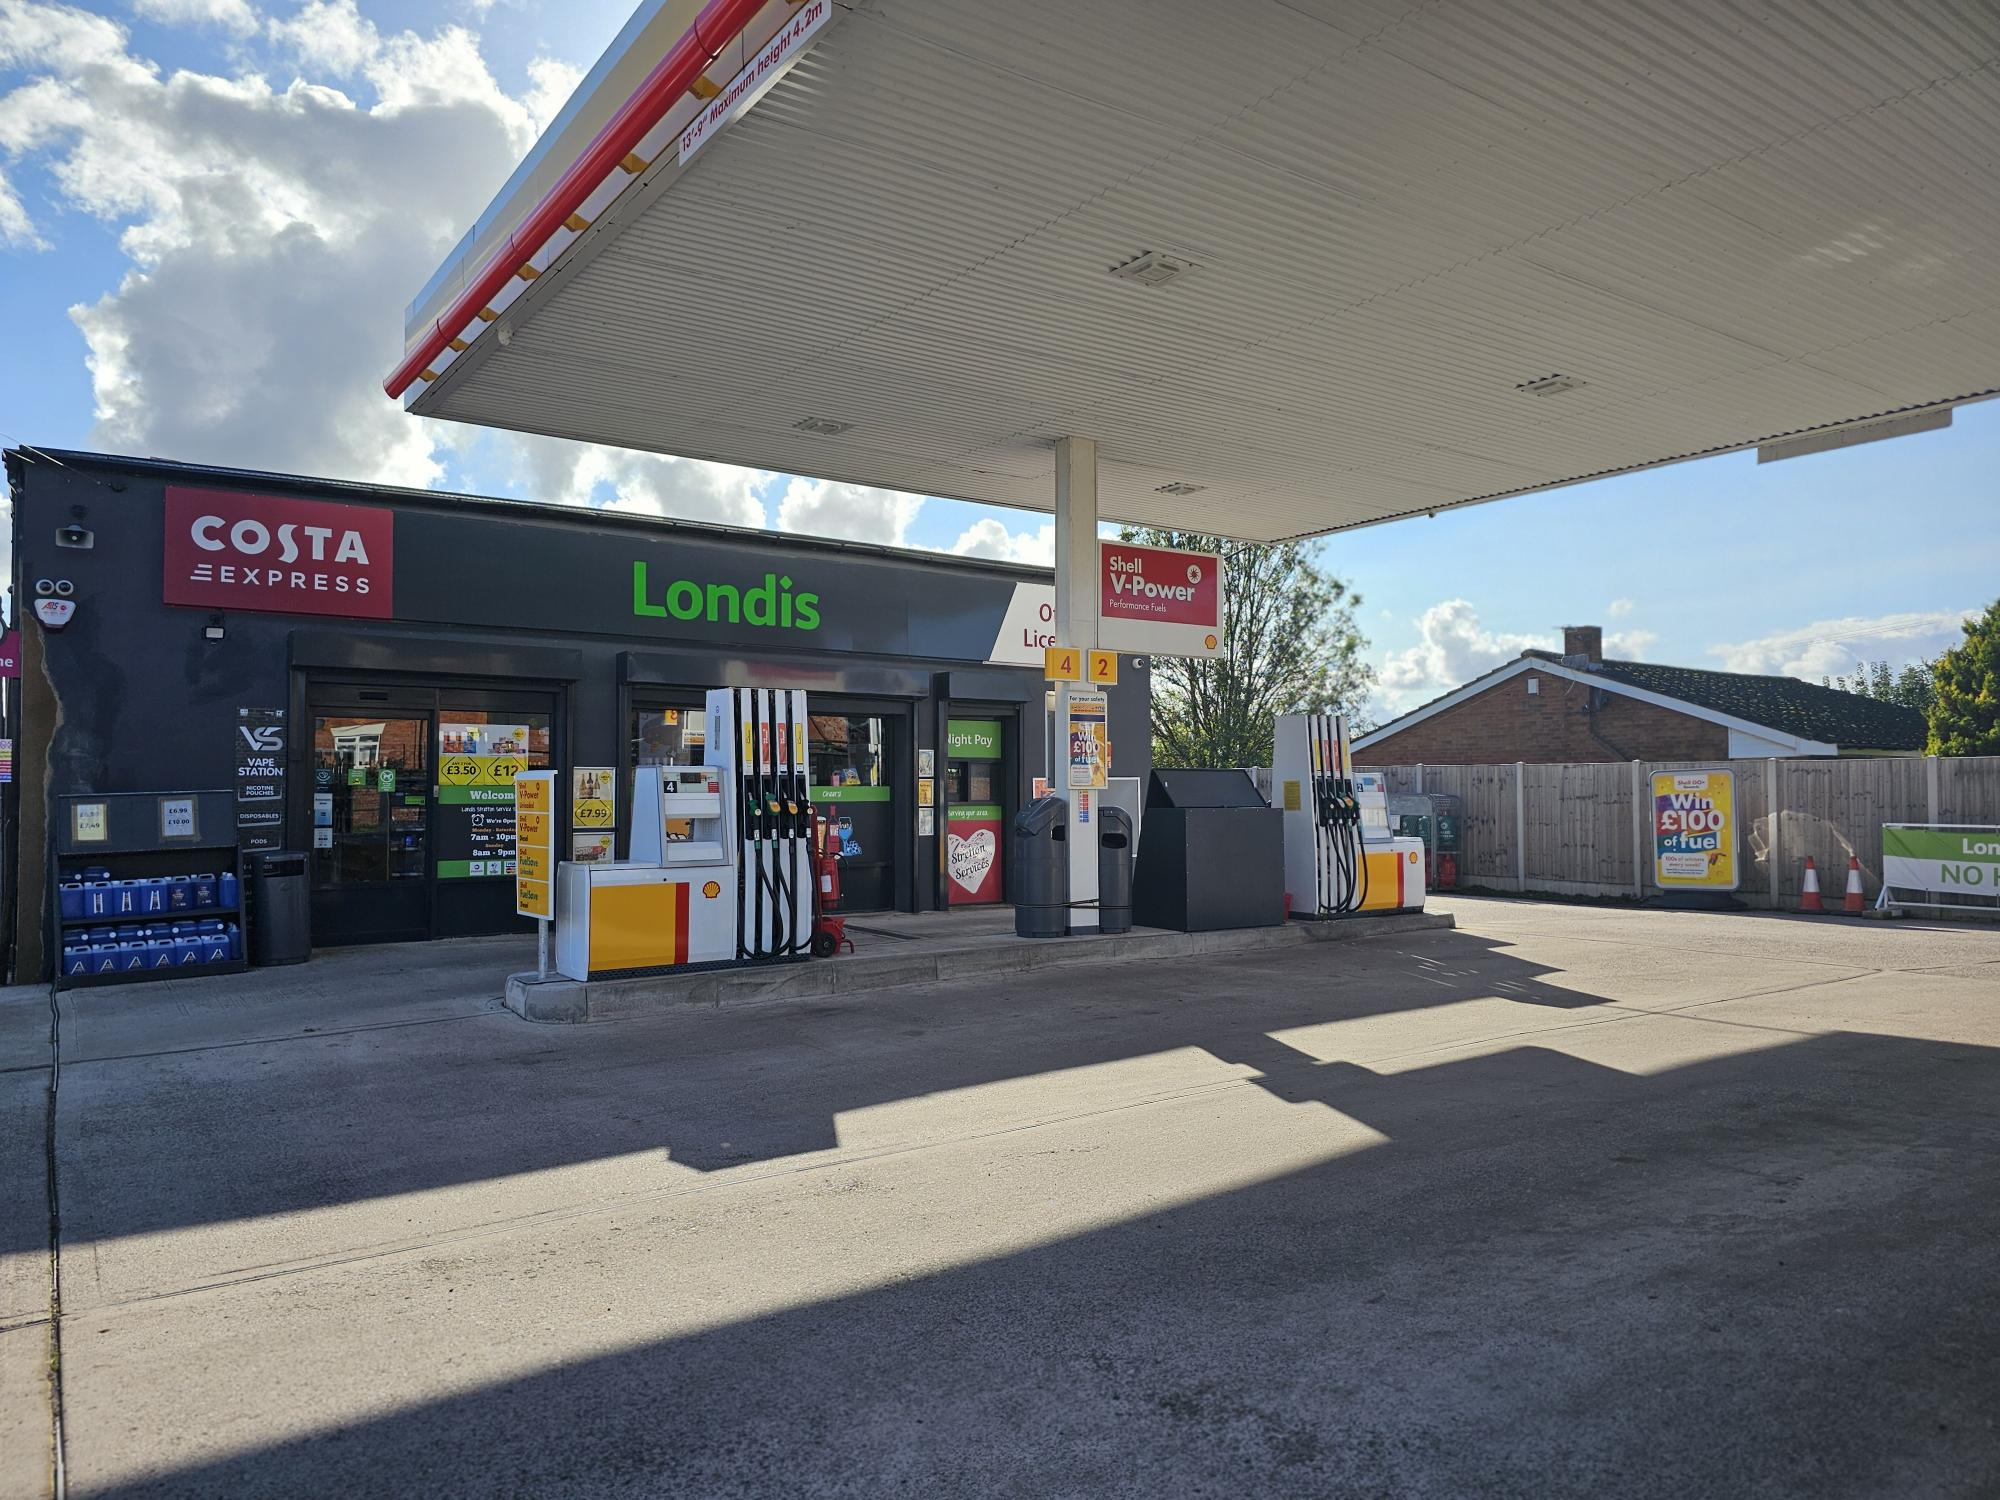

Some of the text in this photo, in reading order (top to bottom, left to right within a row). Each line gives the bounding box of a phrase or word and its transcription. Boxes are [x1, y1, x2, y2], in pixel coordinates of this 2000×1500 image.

[709, 70, 755, 124] Maximum
[756, 31, 791, 76] height
[792, 1, 823, 38] 4.2m
[191, 515, 370, 564] COSTA
[1109, 556, 1142, 574] Shell
[220, 564, 370, 594] EXPRESS
[1110, 572, 1196, 602] V-Power
[633, 560, 820, 630] Londis
[1040, 603, 1055, 622] O
[1109, 599, 1167, 613] Performance Fuels
[1060, 655, 1071, 674] 4
[1098, 658, 1108, 676] 2
[240, 726, 284, 751] VS
[974, 734, 992, 748] Pay
[1078, 731, 1096, 742] Win
[1074, 741, 1100, 753] £100
[248, 758, 274, 767] VAPE
[1081, 754, 1099, 763] fuel
[238, 767, 284, 776] STATION
[447, 766, 476, 775] £3.50
[666, 782, 674, 792] 4
[1670, 793, 1713, 810] Win
[580, 809, 607, 818] £7.99
[1661, 809, 1725, 831] £100
[1664, 830, 1720, 849] of fuel
[956, 860, 990, 879] Services
[1941, 864, 1983, 886] NO
